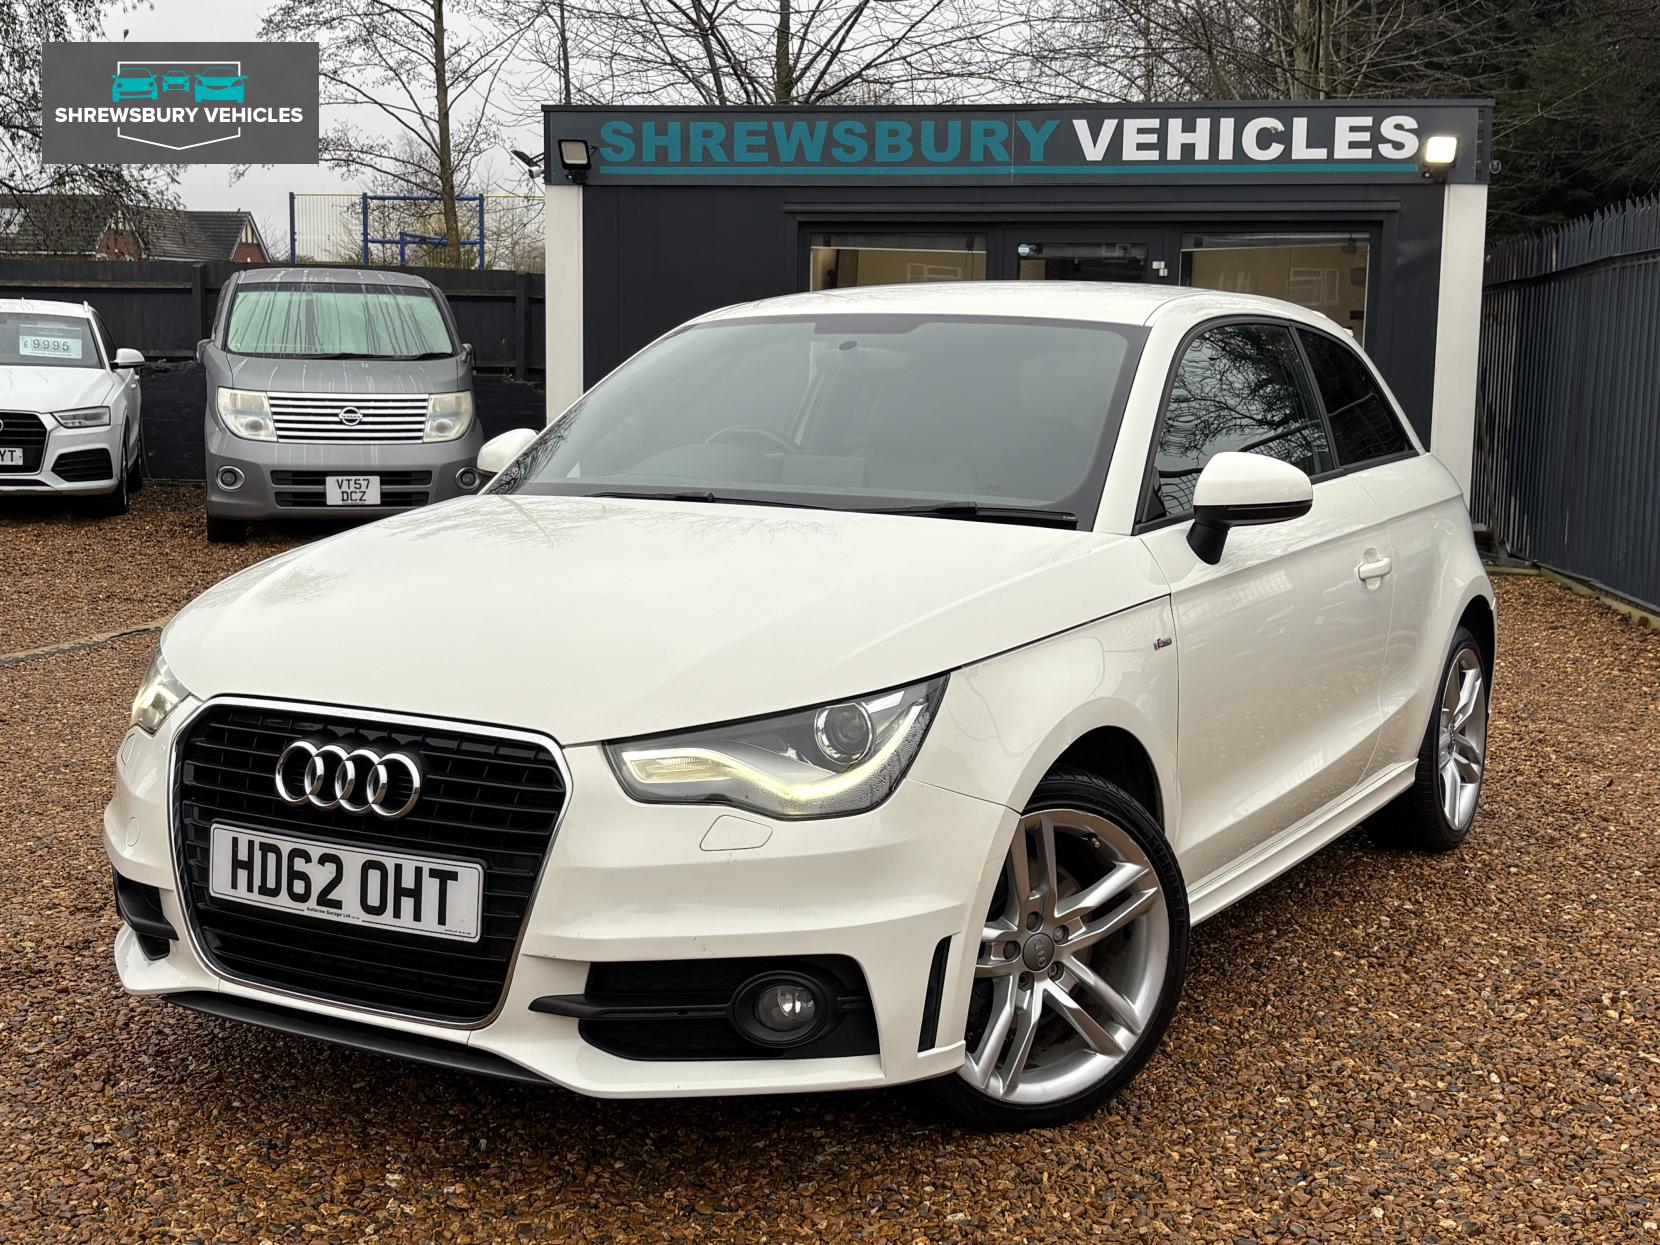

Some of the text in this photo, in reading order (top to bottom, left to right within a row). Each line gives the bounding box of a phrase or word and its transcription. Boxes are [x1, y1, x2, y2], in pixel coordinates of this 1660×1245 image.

[599, 115, 1420, 163] SHREWSBURY VEHICLES
[32, 339, 70, 351] 9995
[336, 478, 370, 490] VT57
[341, 490, 367, 502] DCZ
[231, 836, 459, 926] HD62 OHT
